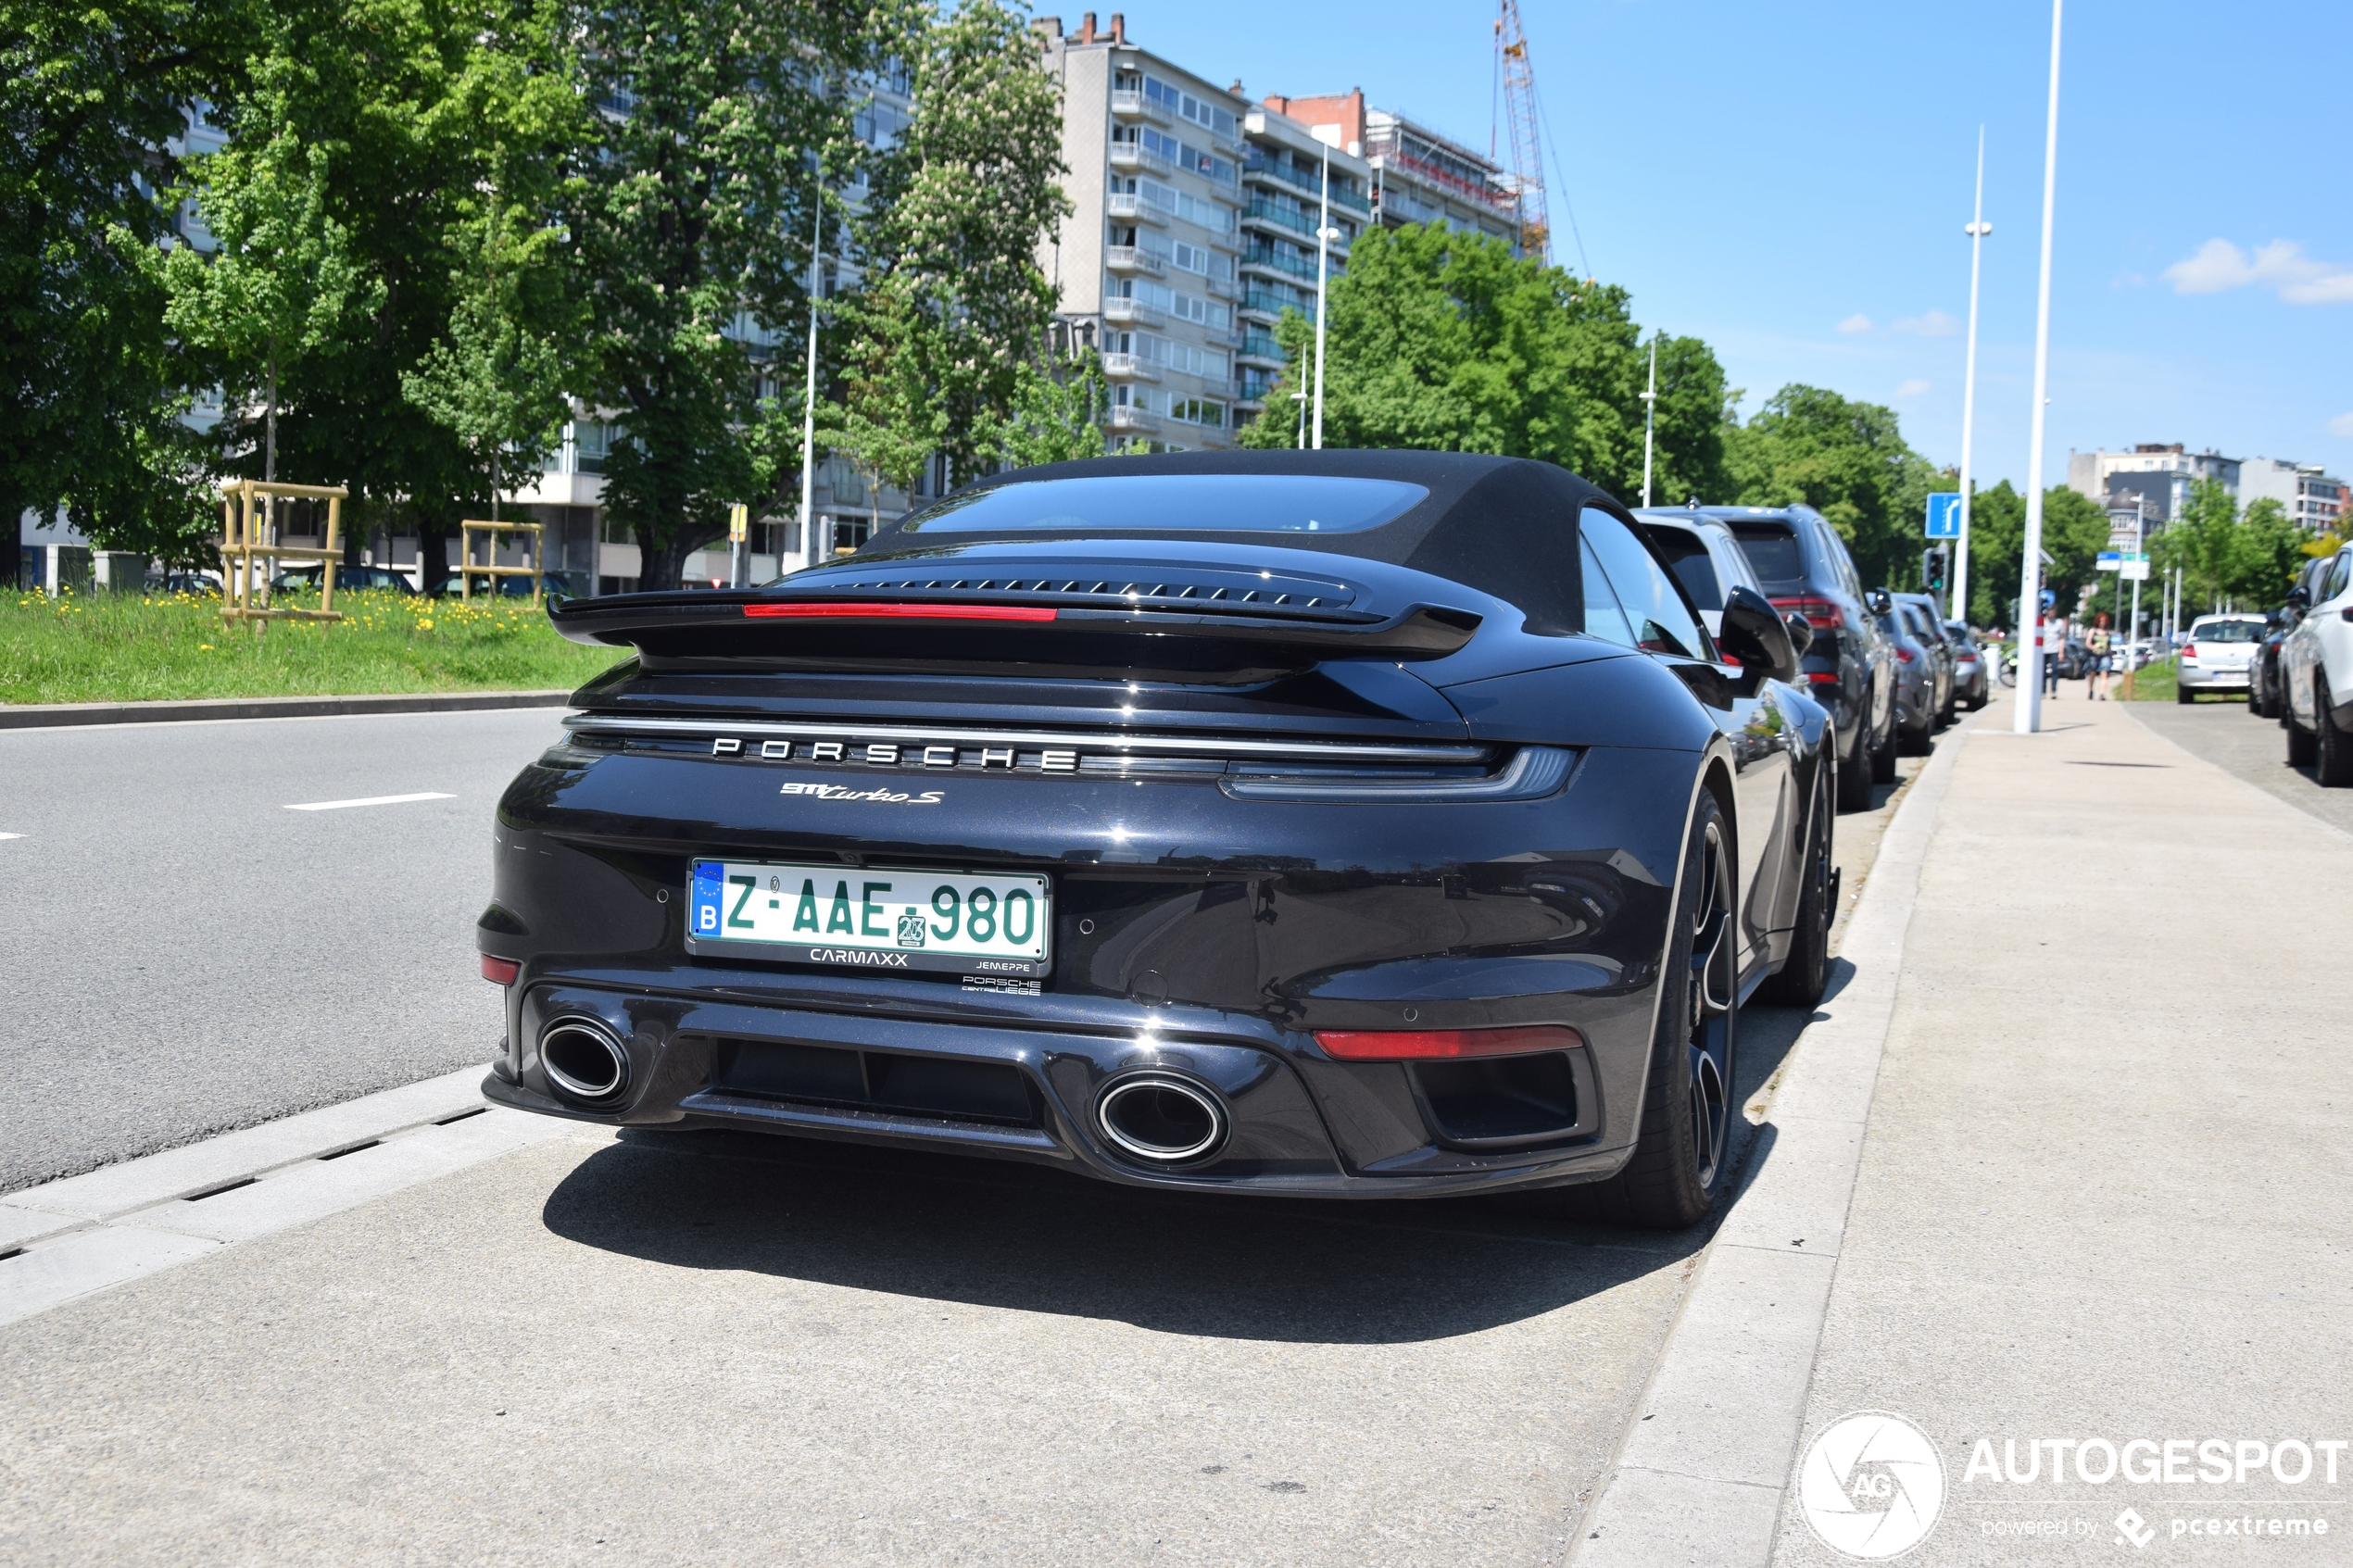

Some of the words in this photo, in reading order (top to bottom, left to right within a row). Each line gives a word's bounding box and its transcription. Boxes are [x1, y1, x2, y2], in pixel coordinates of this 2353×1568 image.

[712, 738, 1078, 771] PORSCHE
[700, 905, 717, 930] B
[810, 948, 908, 967] CARMAXX
[975, 961, 1030, 972] JEMEPPE
[963, 975, 1042, 989] PORSCHE
